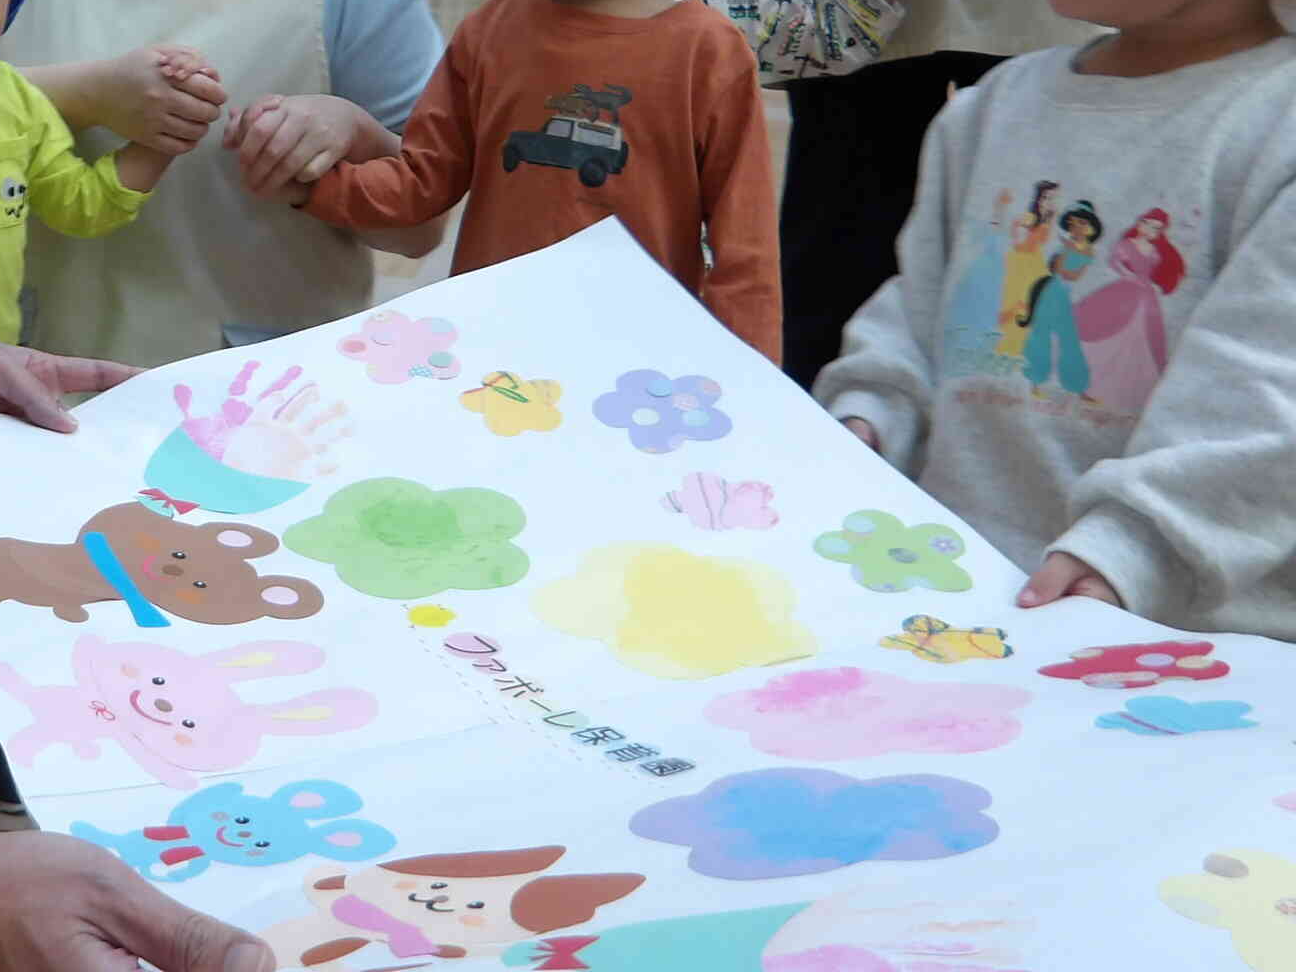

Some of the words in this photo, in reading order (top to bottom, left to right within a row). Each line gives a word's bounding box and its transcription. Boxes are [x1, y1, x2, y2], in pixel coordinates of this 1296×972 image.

[443, 633, 697, 778] ファボーレ保育園
